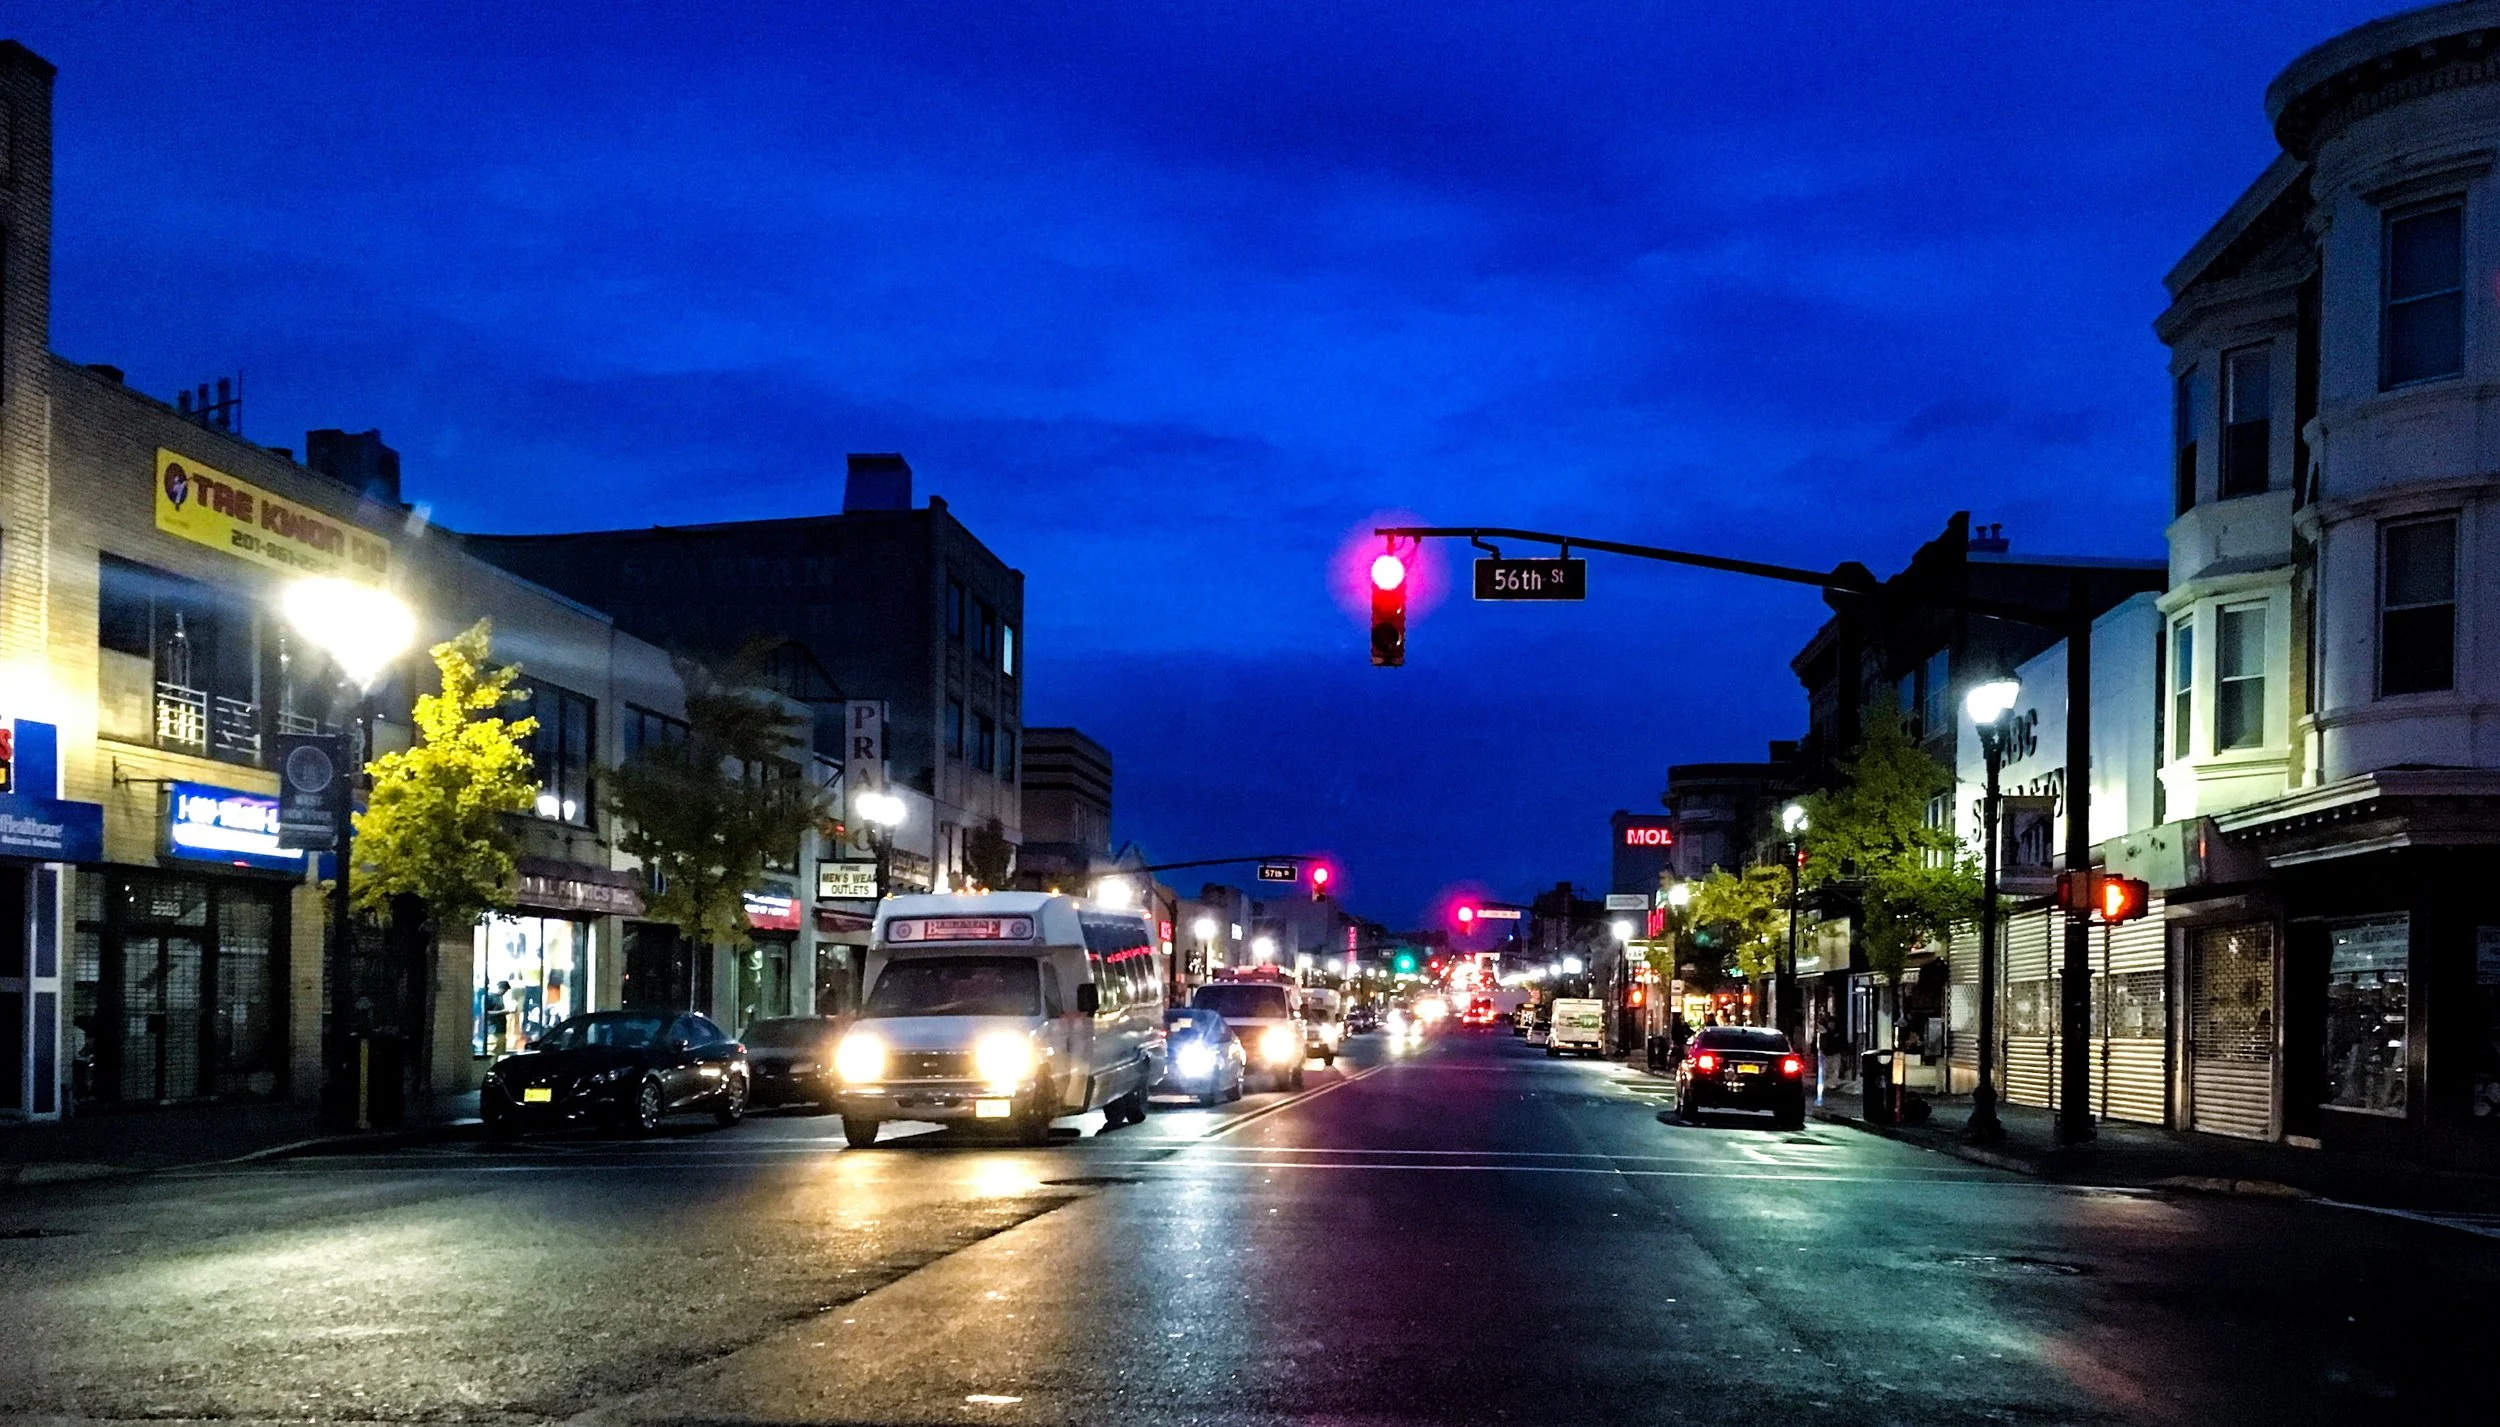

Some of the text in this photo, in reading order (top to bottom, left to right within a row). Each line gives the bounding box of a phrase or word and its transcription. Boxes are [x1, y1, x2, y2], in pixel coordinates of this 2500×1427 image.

[191, 472, 253, 524] TAE
[261, 500, 345, 558] KWON
[1495, 569, 1564, 590] 56th St
[1627, 829, 1672, 845] MOL
[822, 873, 849, 883] MEN'S
[1265, 869, 1283, 878] 57th
[831, 884, 869, 895] OUTLETS
